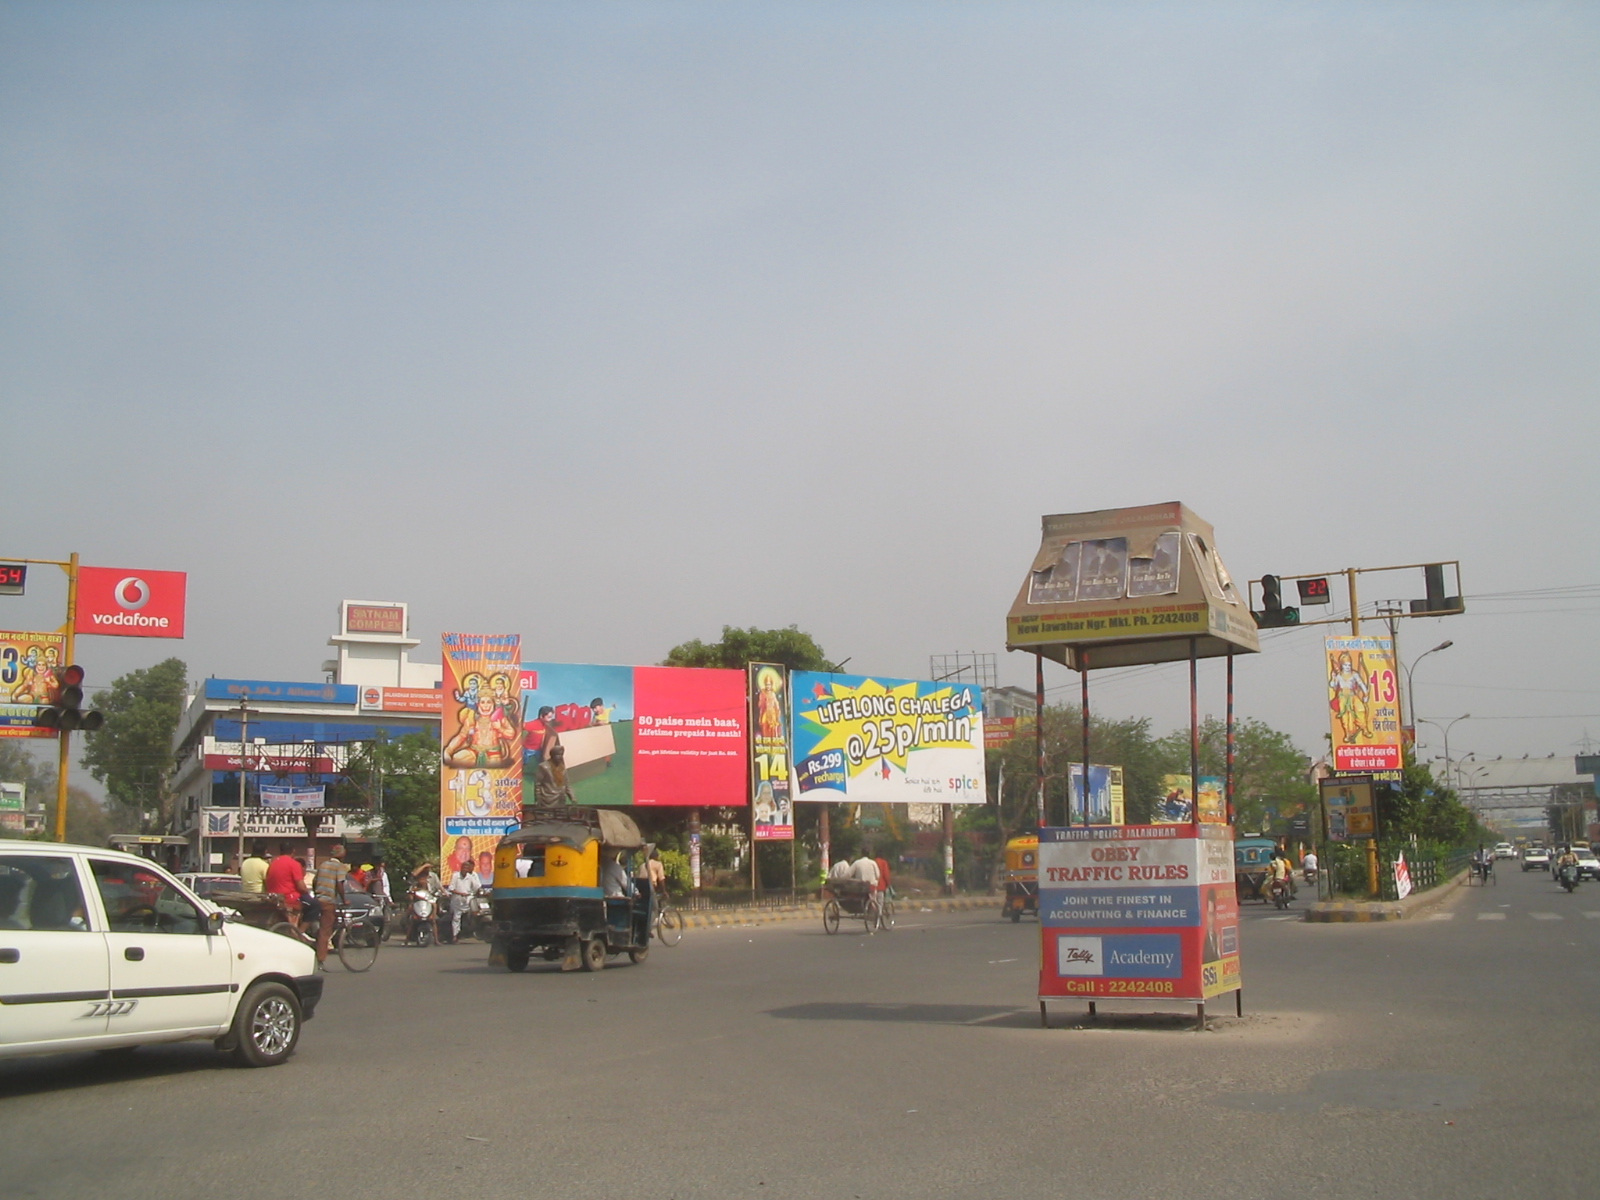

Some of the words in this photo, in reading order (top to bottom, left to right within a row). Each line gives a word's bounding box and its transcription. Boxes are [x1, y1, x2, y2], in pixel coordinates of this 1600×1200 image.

[92, 612, 169, 628] vodafone
[353, 608, 399, 620] SATNAM
[349, 619, 402, 630] COMPLEX
[1017, 624, 1039, 635] New
[1041, 620, 1084, 632] Jawahar
[1086, 618, 1107, 631] Ngr.
[1133, 614, 1149, 626] Ph.
[1152, 611, 1199, 625] 2242408
[1369, 669, 1396, 703] 13
[817, 694, 897, 724] LIFELONG
[899, 687, 973, 716] CHALEGA
[638, 715, 653, 726] 50
[654, 716, 684, 727] paise
[685, 716, 712, 727] mein
[713, 717, 740, 729] baat,
[638, 728, 673, 737] Lifetime
[673, 729, 705, 738] prepaid
[706, 729, 716, 738] ke
[716, 730, 742, 738] saath!
[847, 713, 973, 766] @25p/min
[755, 753, 788, 781] 14
[807, 752, 842, 775] Rs.299
[814, 770, 845, 784] recharge
[948, 774, 979, 793] spice
[448, 768, 494, 817] 13
[236, 814, 300, 826] SATNAM
[1055, 829, 1090, 840] TRAFFIC
[1093, 828, 1123, 839] POLICE
[1126, 827, 1177, 839] JALANDHAR
[1091, 846, 1140, 862] OBEY
[1046, 865, 1123, 882] TRAFFIC
[1128, 864, 1189, 881] RULES
[1062, 896, 1089, 906] JOIN
[1091, 896, 1114, 905] THE
[1116, 895, 1157, 905] FINEST
[1160, 895, 1172, 904] IN
[1049, 910, 1122, 920] ACCOUNTING
[1125, 910, 1134, 919] &
[1137, 909, 1187, 919] FINANCE
[1067, 948, 1094, 963] Tally
[1110, 949, 1174, 969] Academy
[1067, 981, 1095, 993] Call
[1108, 981, 1174, 994] 2242408
